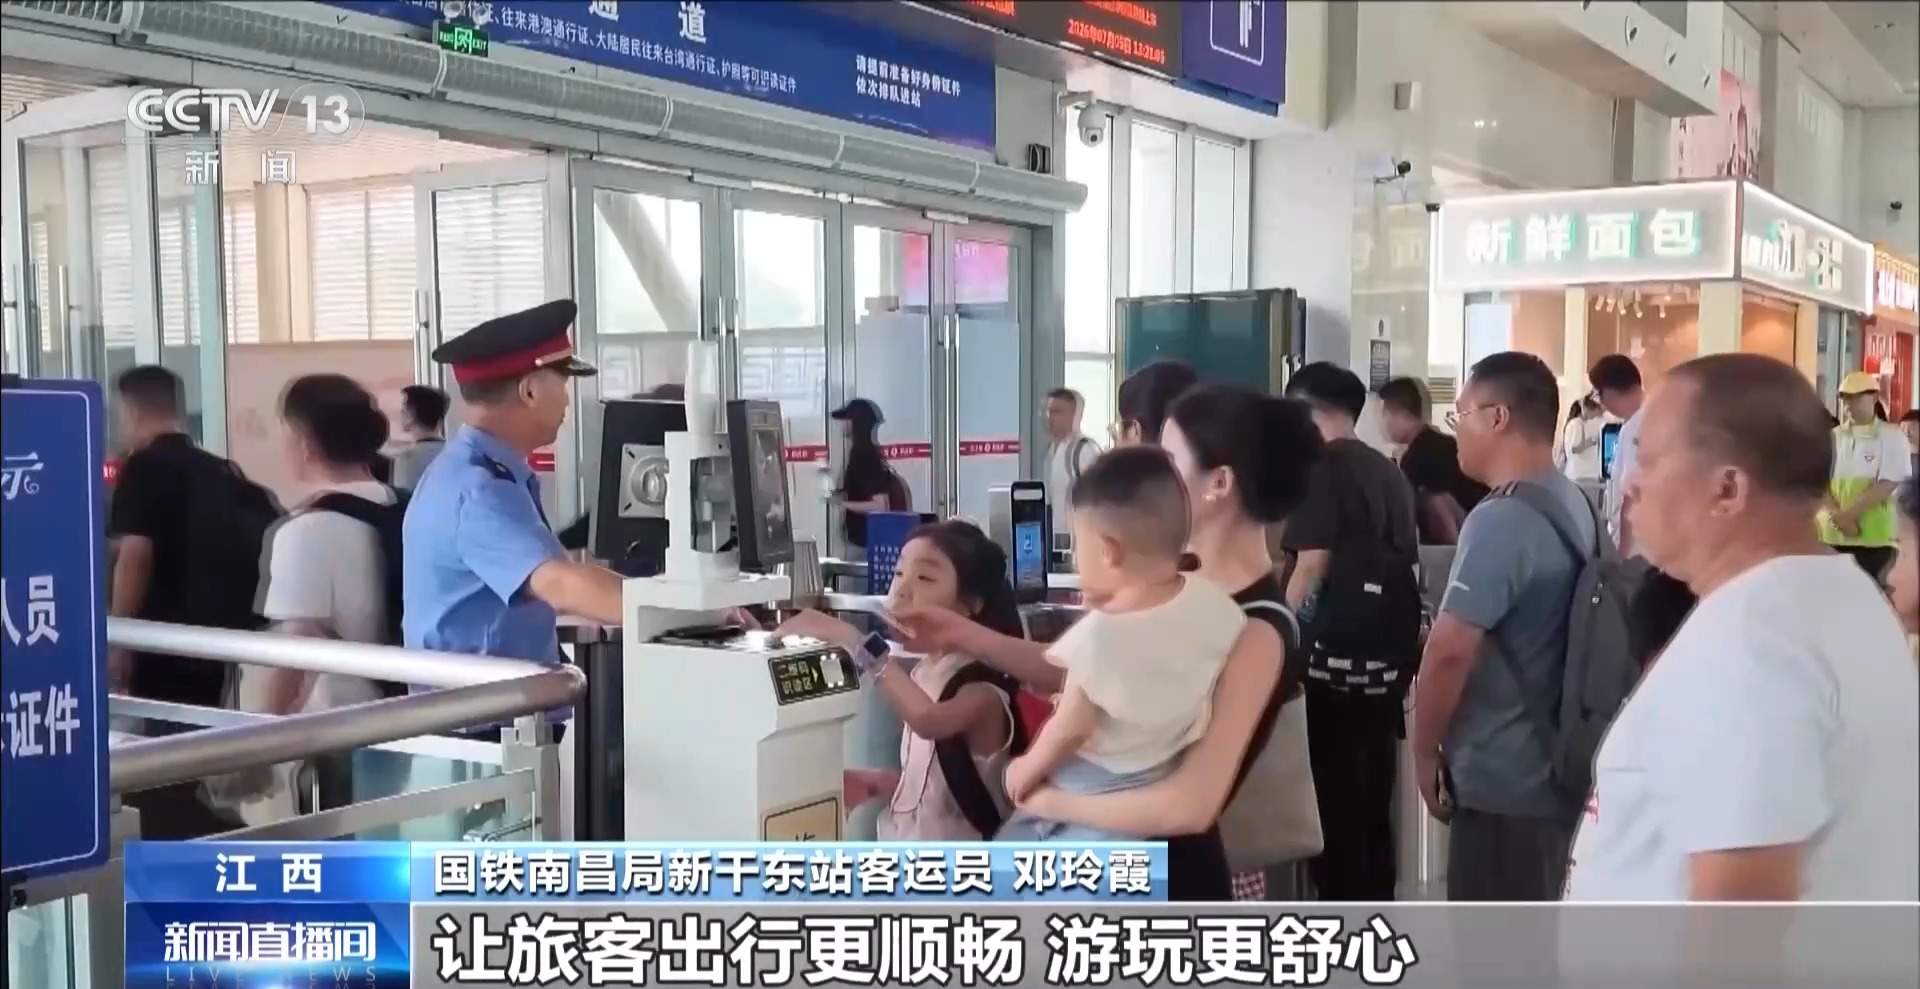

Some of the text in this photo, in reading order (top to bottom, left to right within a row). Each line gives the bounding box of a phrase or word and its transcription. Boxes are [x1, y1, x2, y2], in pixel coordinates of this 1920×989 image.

[856, 54, 960, 96] 请提前准备好身份证件
[856, 75, 921, 108] 依次排队进站
[1466, 208, 1702, 264] 新鲜面包
